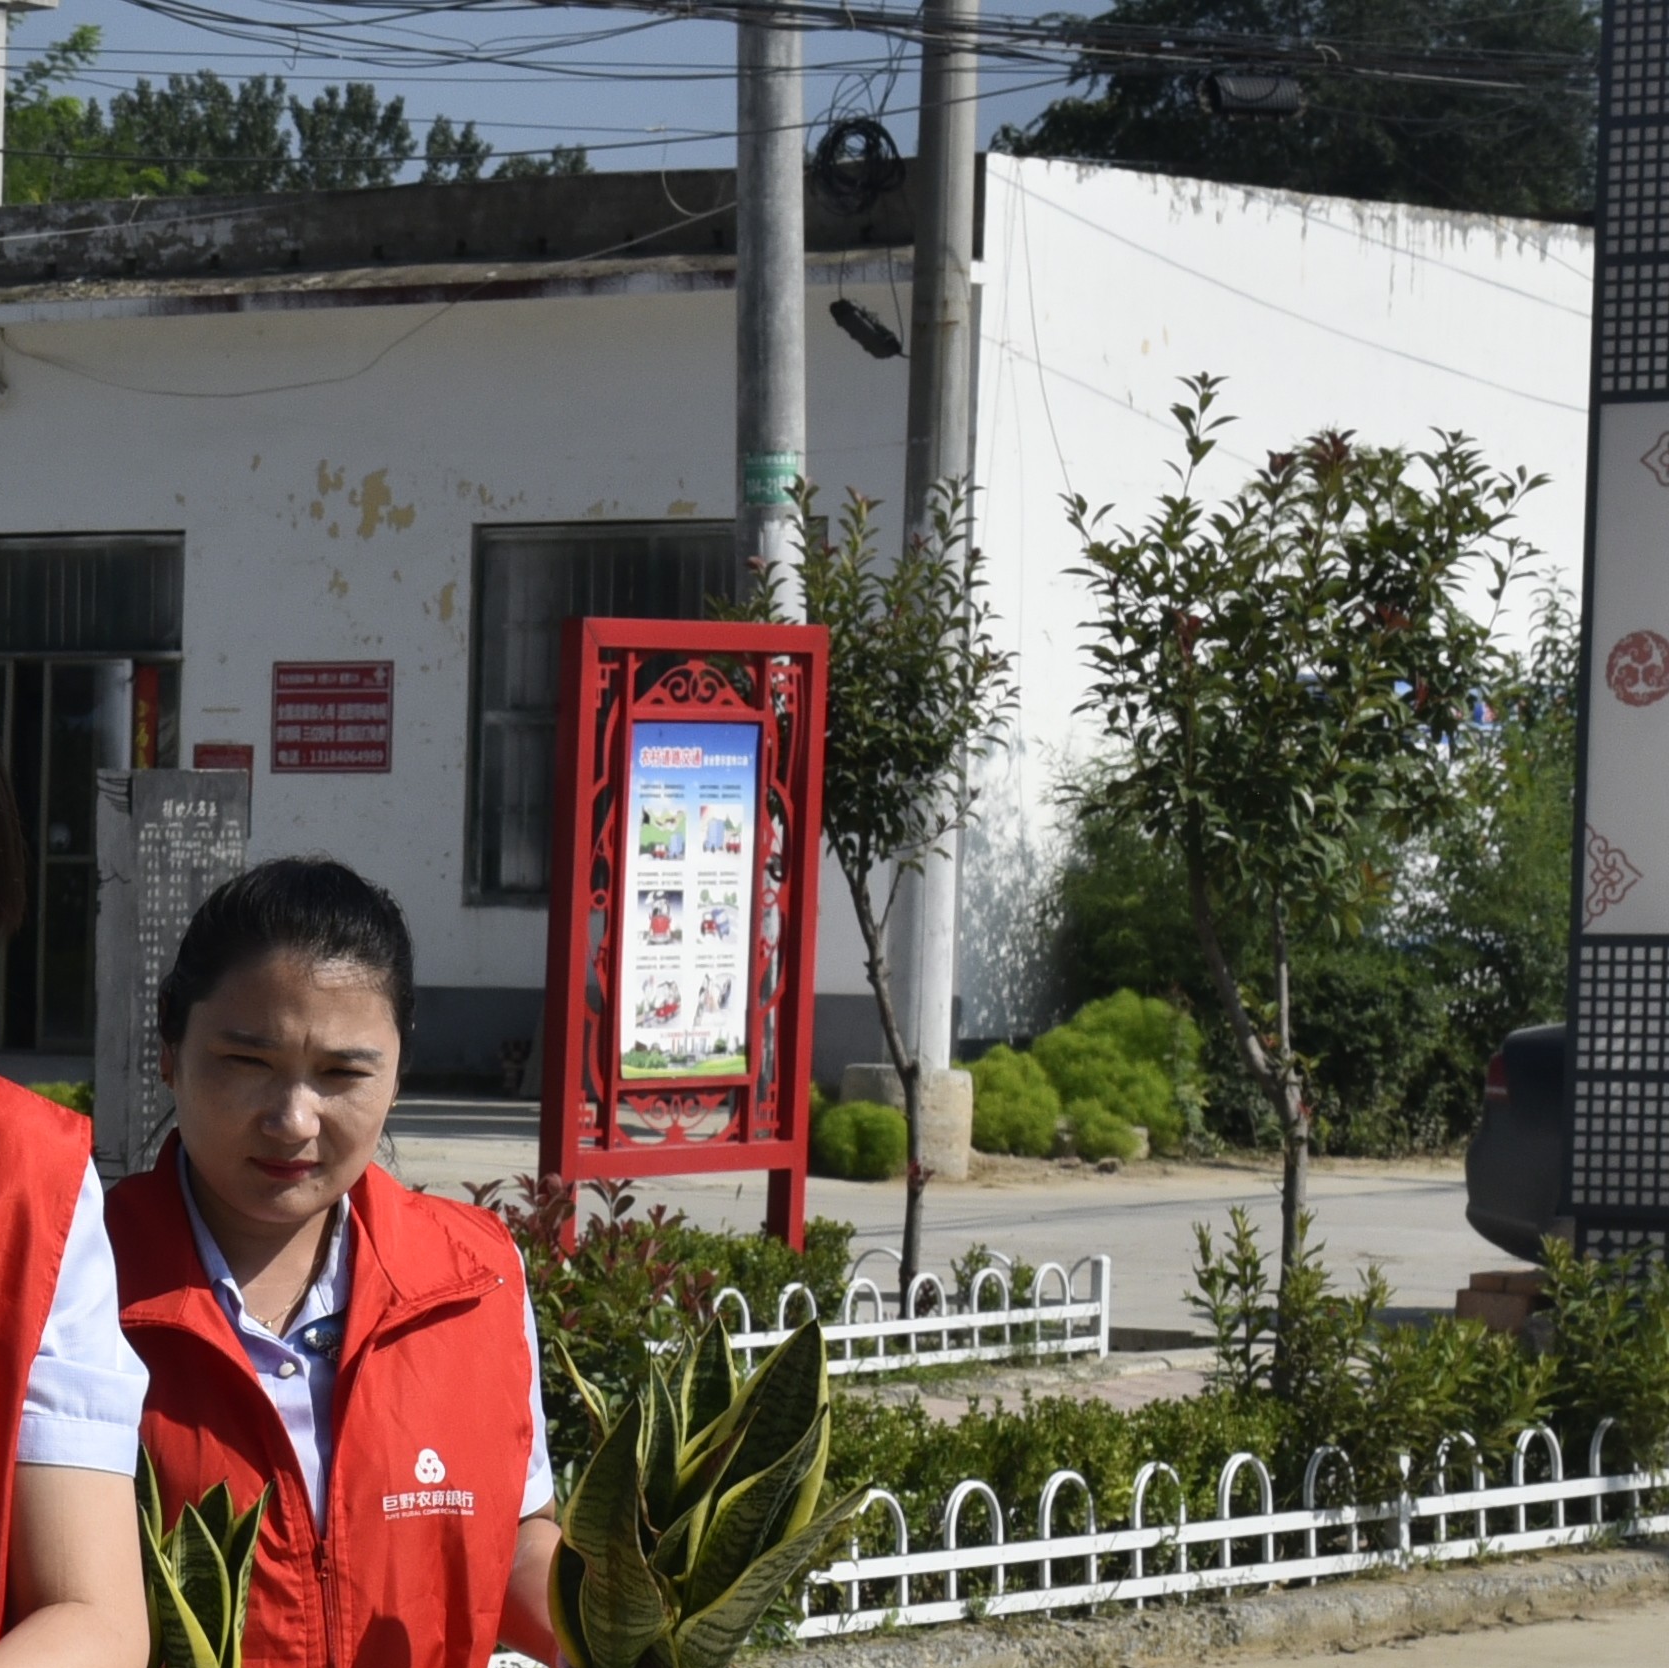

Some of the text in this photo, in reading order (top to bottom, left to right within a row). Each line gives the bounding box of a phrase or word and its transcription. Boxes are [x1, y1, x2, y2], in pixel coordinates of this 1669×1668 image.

[382, 1490, 475, 1512] 巨野农商银行
